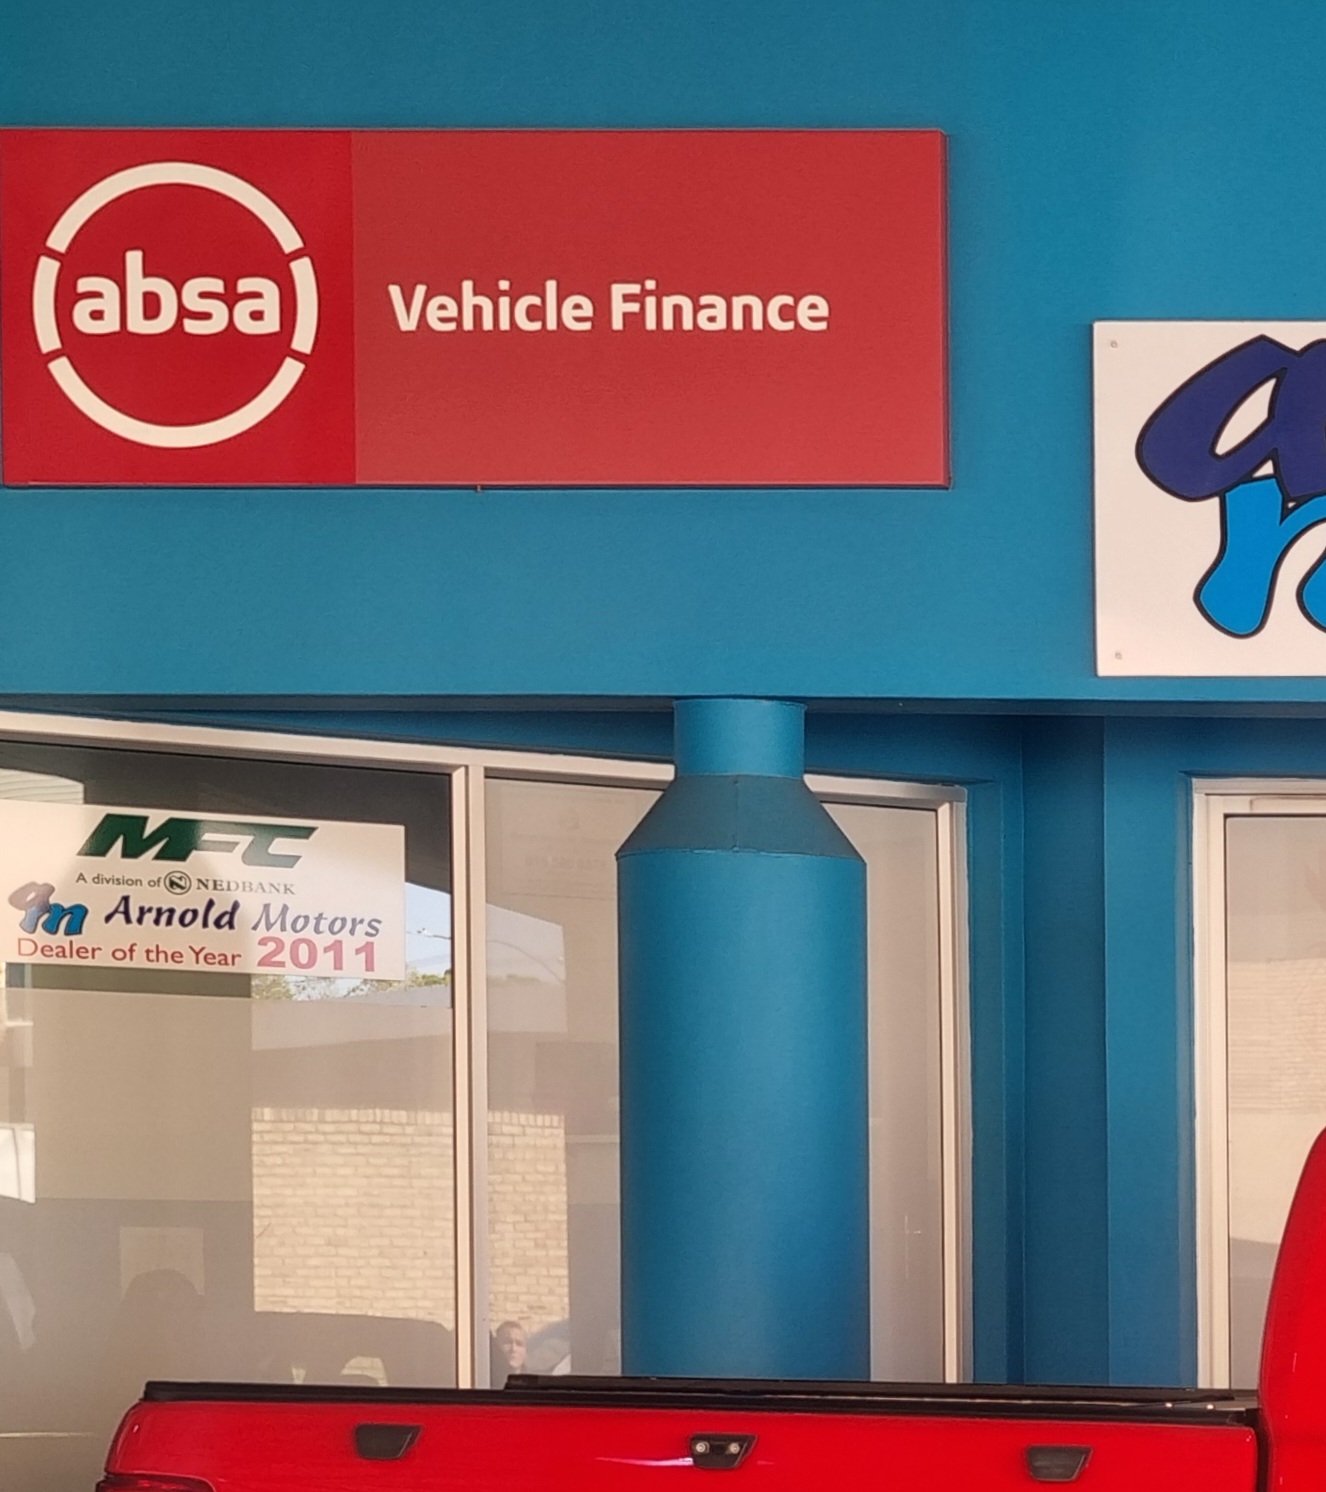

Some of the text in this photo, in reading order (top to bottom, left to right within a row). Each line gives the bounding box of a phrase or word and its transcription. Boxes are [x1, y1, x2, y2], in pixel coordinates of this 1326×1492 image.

[72, 249, 281, 335] absa
[388, 279, 829, 332] Vehicle Finance
[76, 813, 319, 869] MFC
[75, 872, 296, 895] A division of NEDBANK
[104, 895, 383, 938] Arnold Motors
[17, 936, 377, 973] Dealer of the Year 2011
